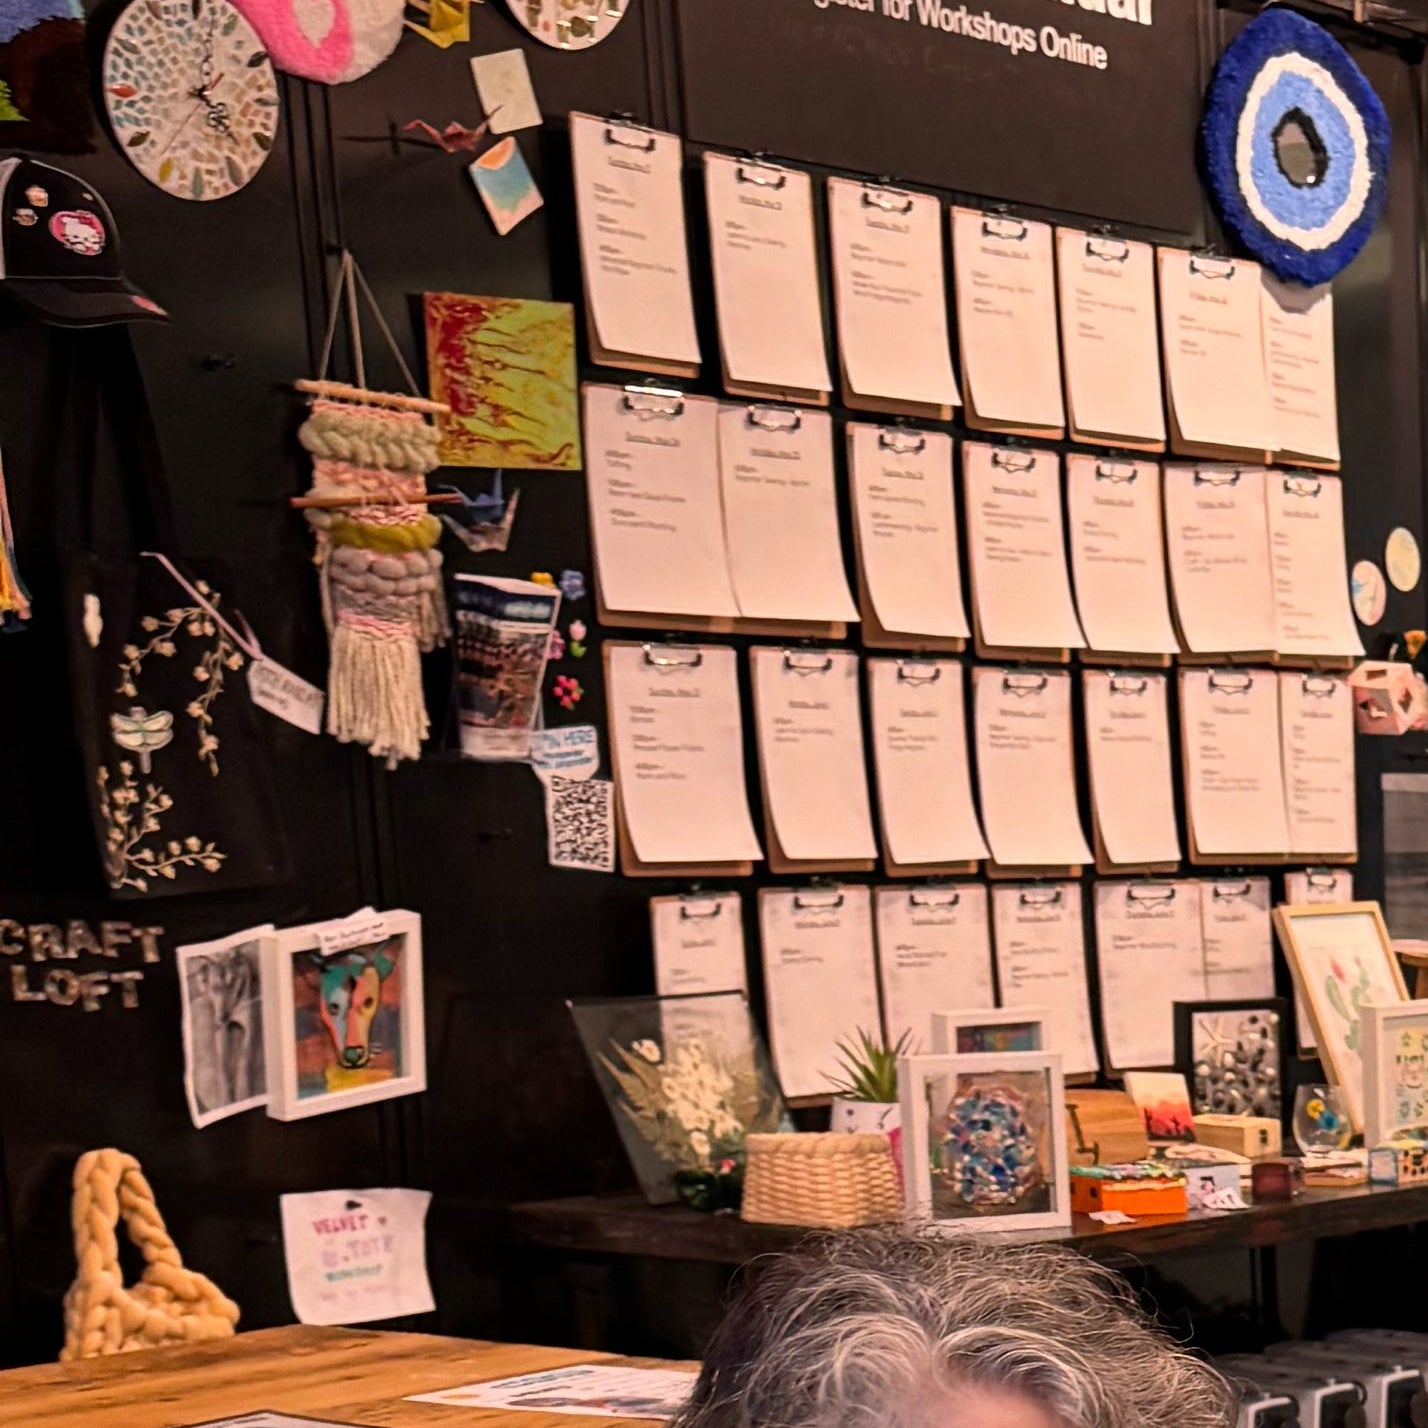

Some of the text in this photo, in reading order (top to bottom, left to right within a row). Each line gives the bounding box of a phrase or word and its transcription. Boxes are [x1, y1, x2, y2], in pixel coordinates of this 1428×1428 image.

[917, 0, 1037, 55] Workshops
[1040, 26, 1109, 69] Online
[0, 919, 164, 962] CRAFT
[10, 964, 144, 1012] LOFT
